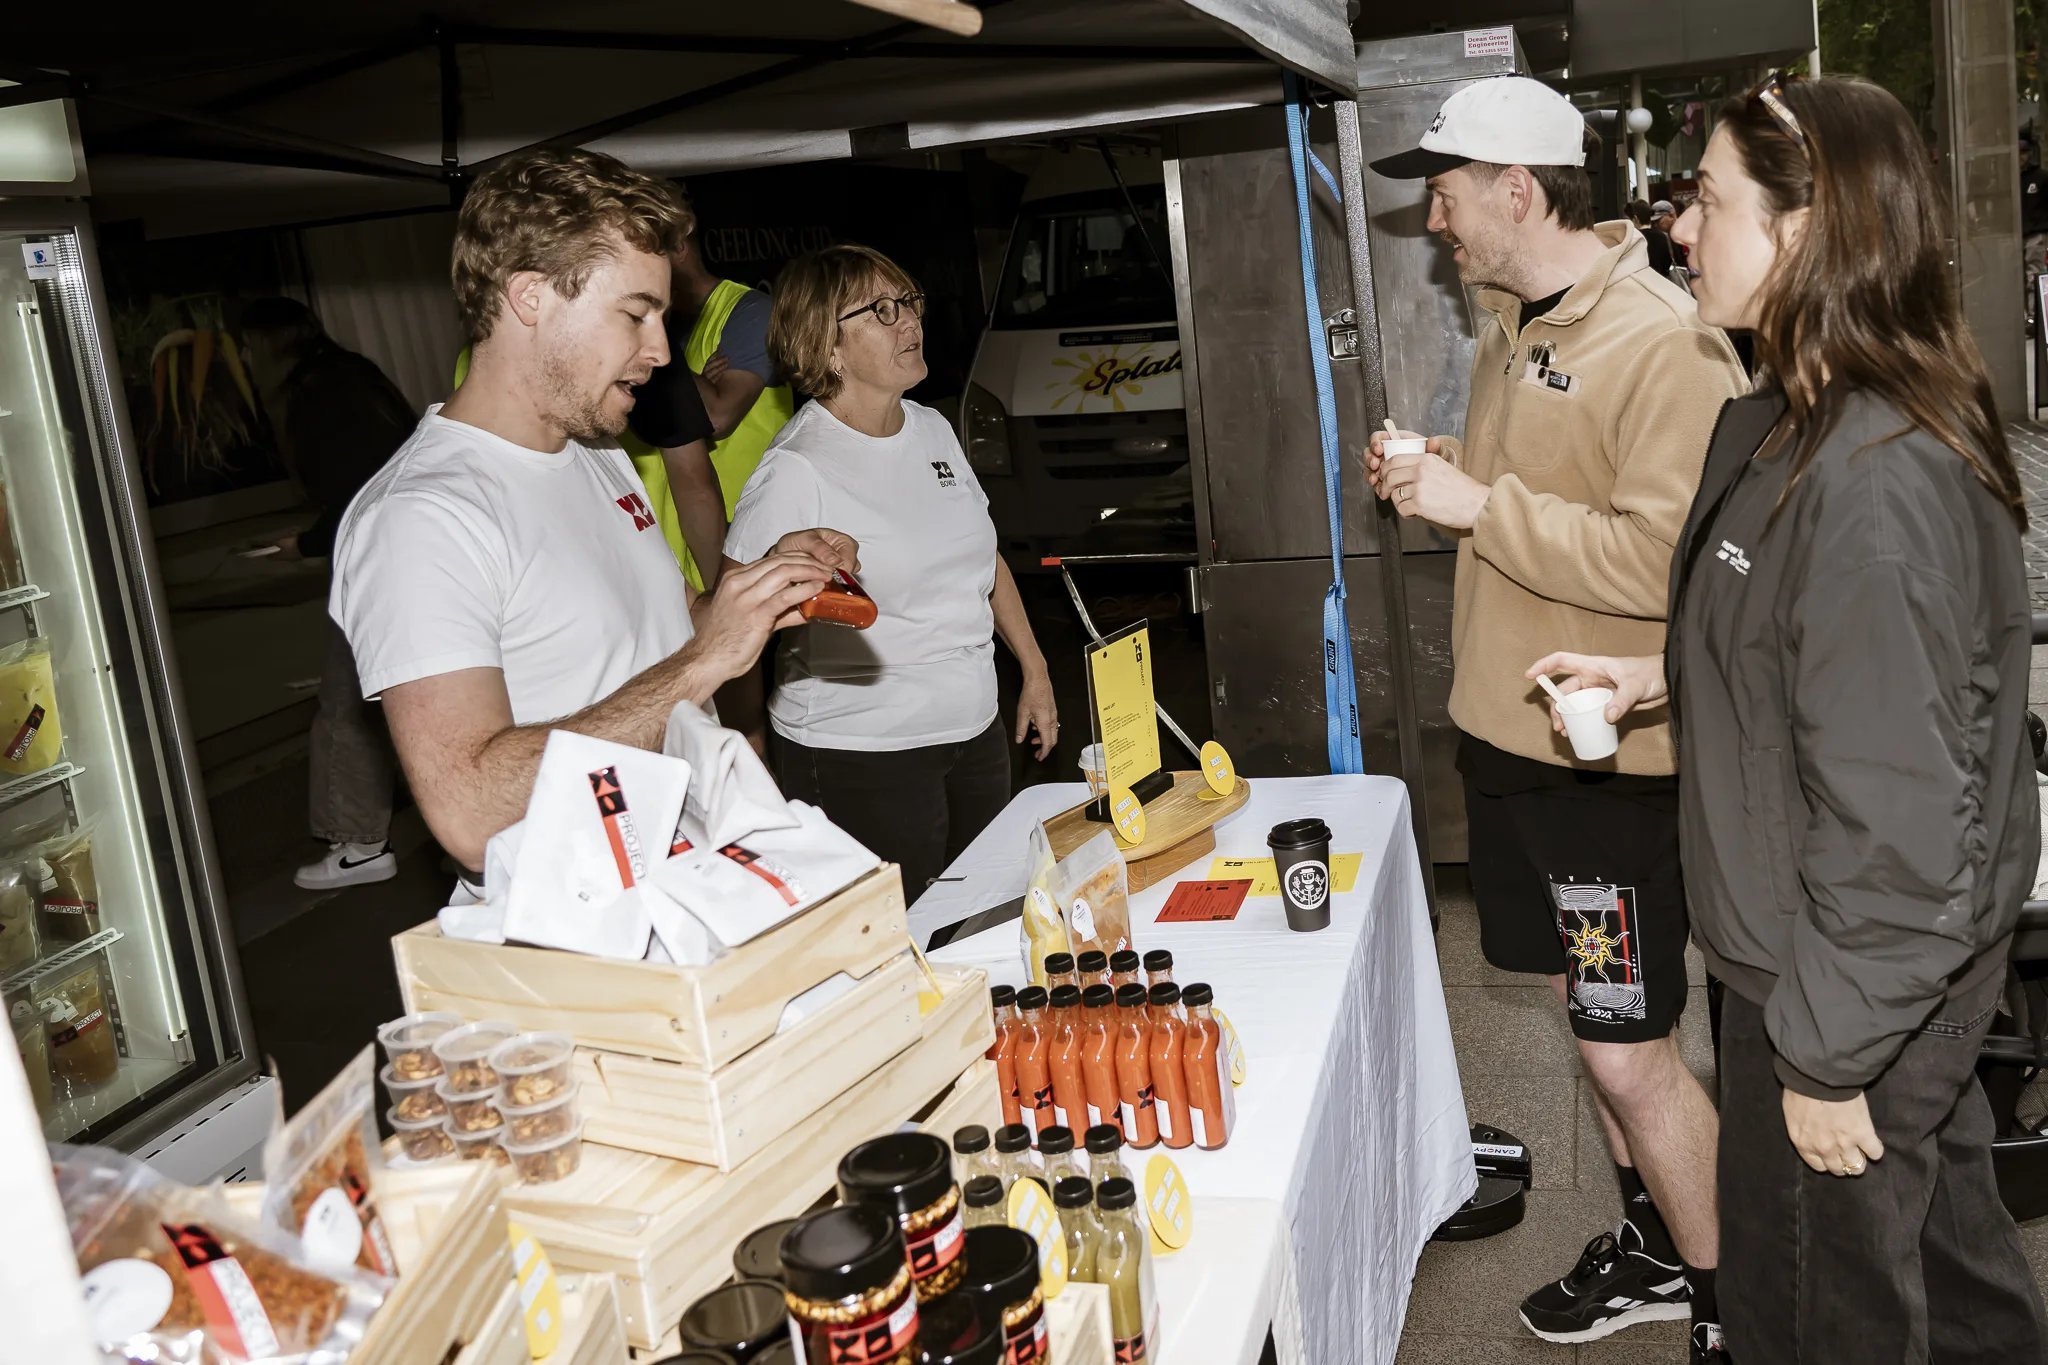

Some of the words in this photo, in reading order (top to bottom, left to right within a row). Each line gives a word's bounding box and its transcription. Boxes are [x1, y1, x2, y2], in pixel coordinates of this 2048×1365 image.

[1468, 40, 1509, 49] Engineering
[704, 226, 799, 263] GEELONG
[14, 728, 36, 761] PROJECT
[45, 904, 82, 914] PROJECT
[75, 1009, 102, 1030] PROJECT
[1586, 1008, 1613, 1020] バランス
[1474, 1146, 1516, 1155] CANOPY
